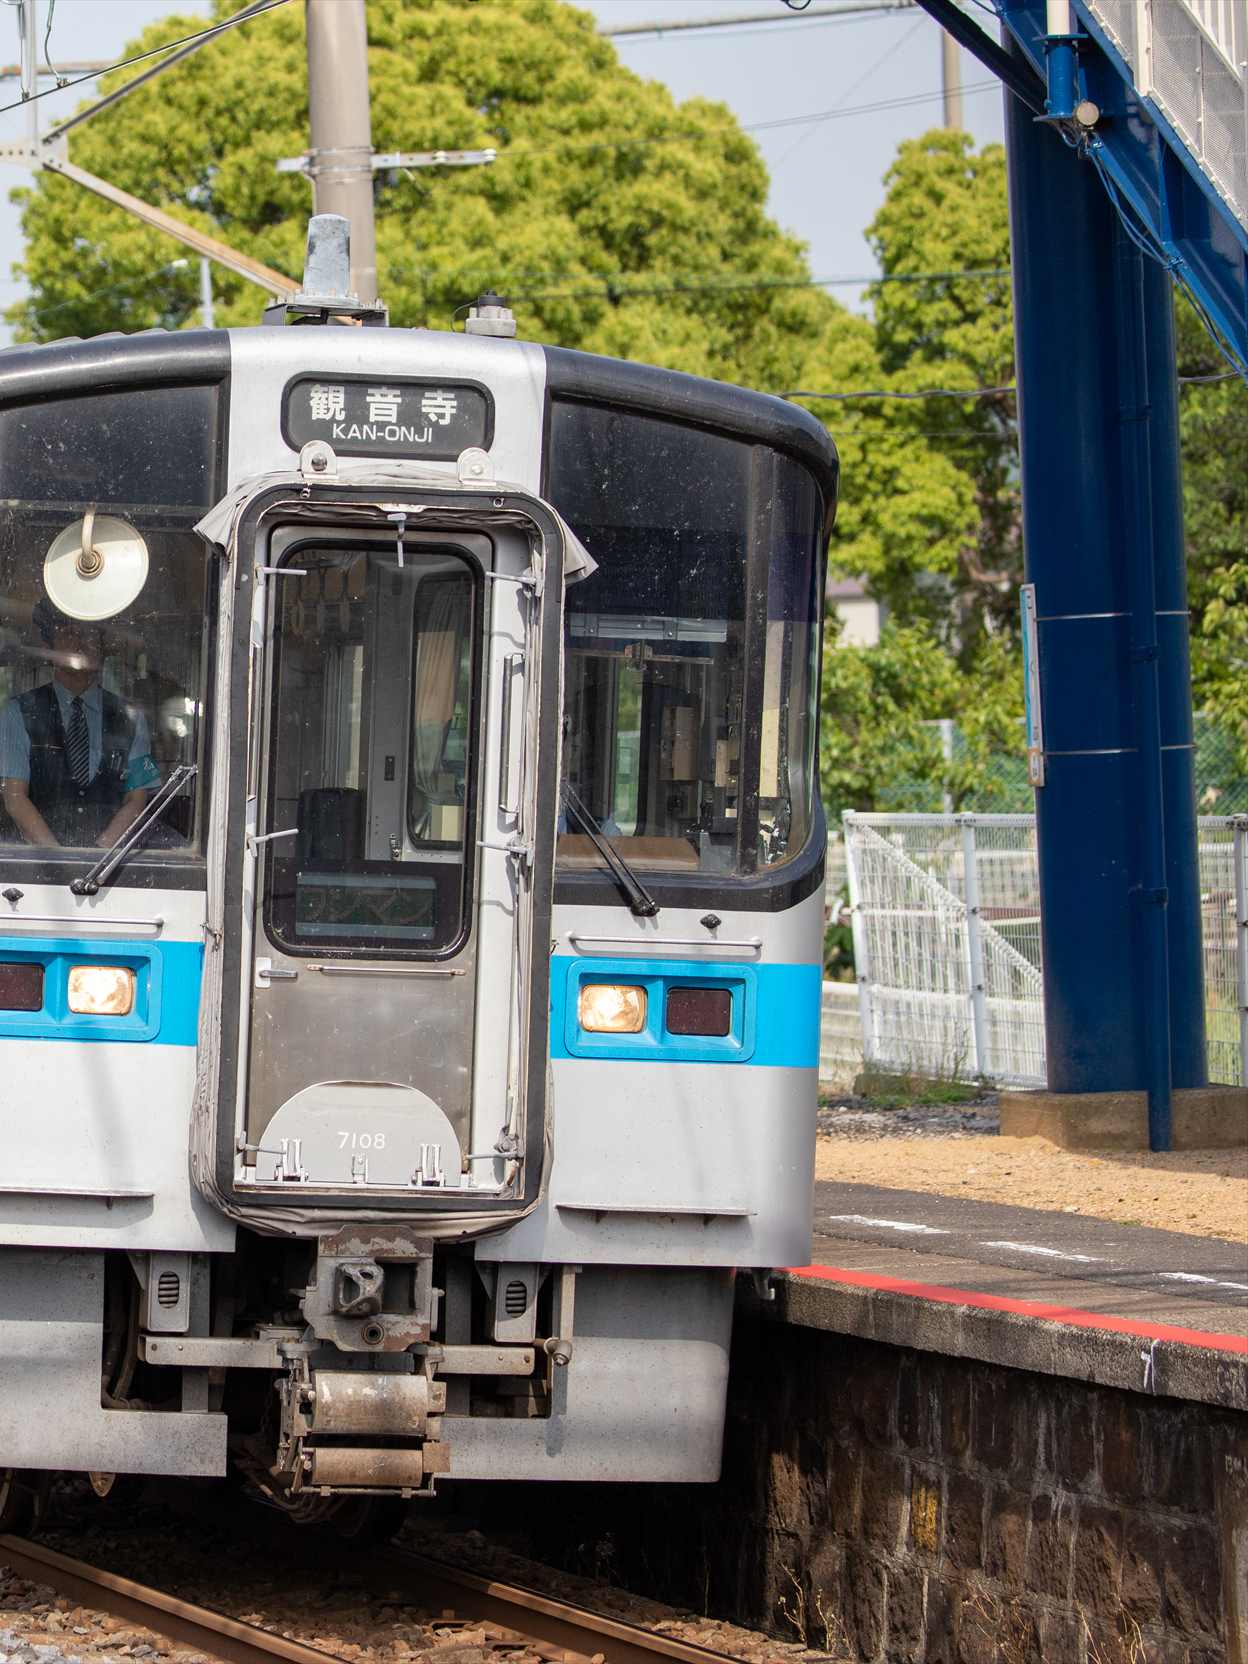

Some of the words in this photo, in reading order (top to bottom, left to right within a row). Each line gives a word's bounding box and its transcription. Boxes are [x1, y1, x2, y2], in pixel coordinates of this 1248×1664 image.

[309, 384, 457, 425] 観音寺
[332, 423, 433, 443] KAN-ONJI
[337, 1132, 386, 1149] 7108
